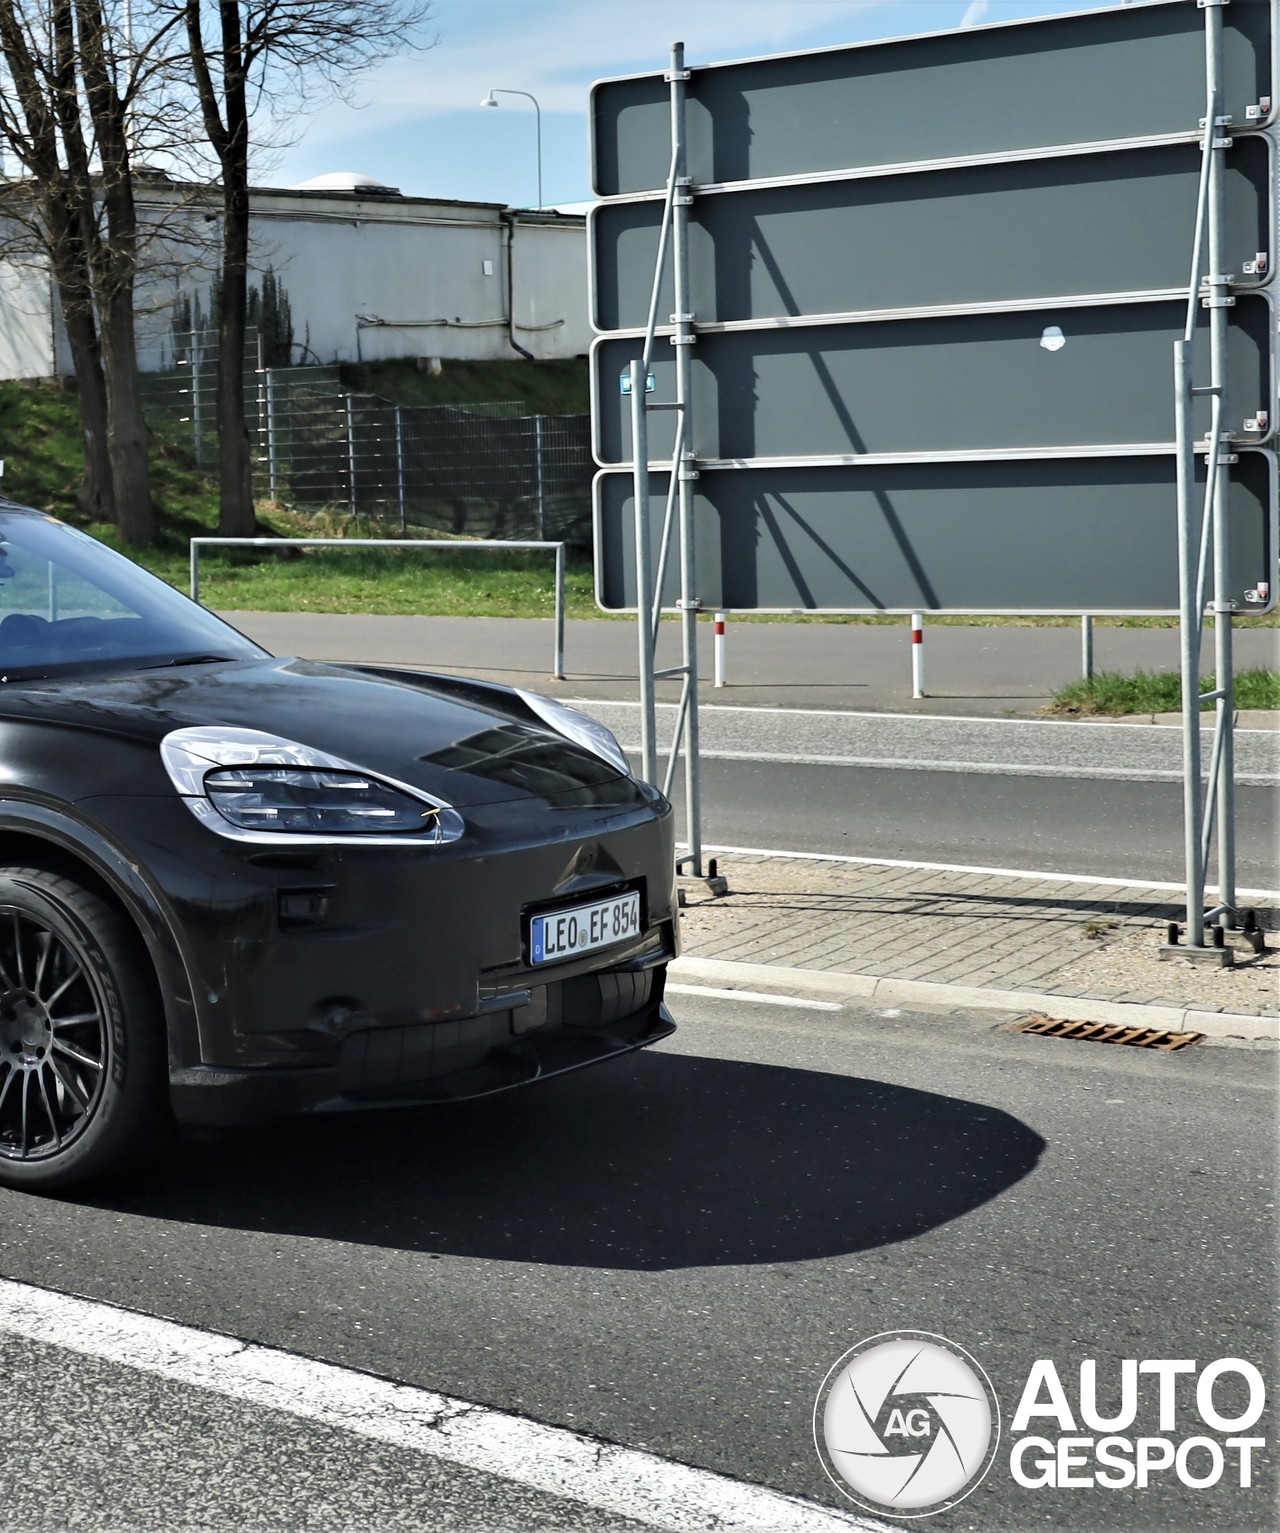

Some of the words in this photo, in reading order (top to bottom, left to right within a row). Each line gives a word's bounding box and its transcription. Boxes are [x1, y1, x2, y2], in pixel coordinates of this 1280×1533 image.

[535, 944, 541, 955] D
[545, 915, 578, 955] LEO
[590, 907, 610, 944] EF
[612, 899, 638, 937] 854
[99, 972, 124, 1045] ZERO
